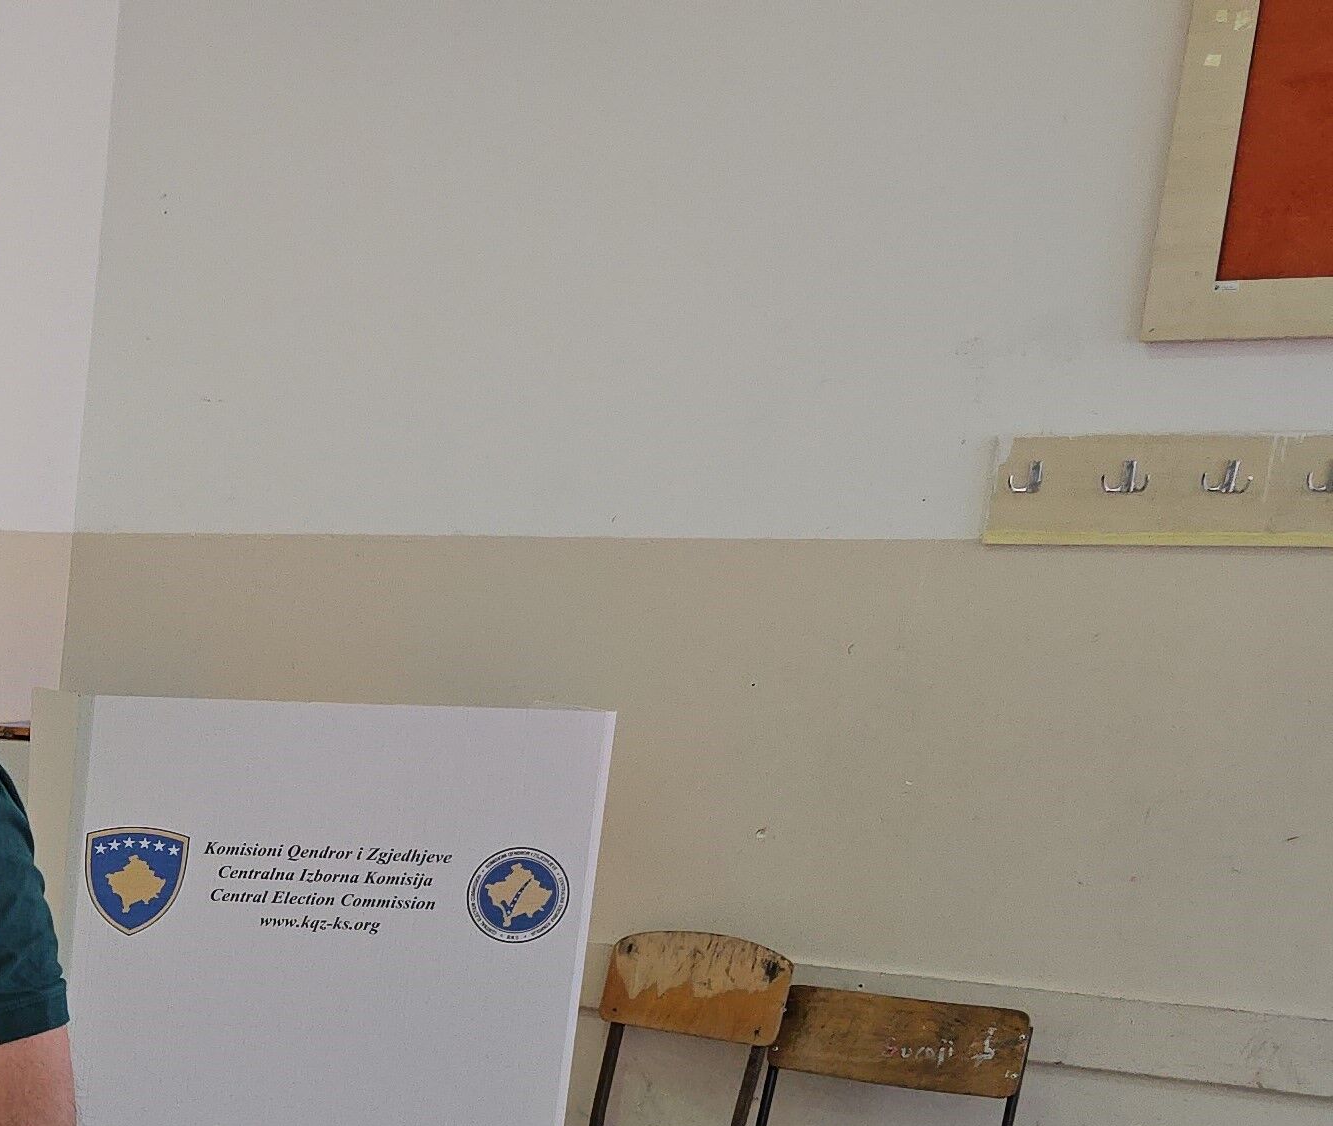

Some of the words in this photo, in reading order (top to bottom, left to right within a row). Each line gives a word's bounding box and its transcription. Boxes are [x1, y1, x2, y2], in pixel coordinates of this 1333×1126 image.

[204, 841, 283, 857] Komisioni
[287, 844, 353, 861] Qendror
[356, 847, 364, 861] i
[365, 847, 453, 867] Zgjedhjeve
[218, 865, 295, 881] Centralna
[299, 868, 360, 884] Izborna
[363, 871, 433, 890] Komisija
[210, 888, 269, 904] Central
[271, 890, 335, 906] Election
[340, 893, 436, 911] Commission
[260, 915, 381, 935] www.kqz-ks.org
